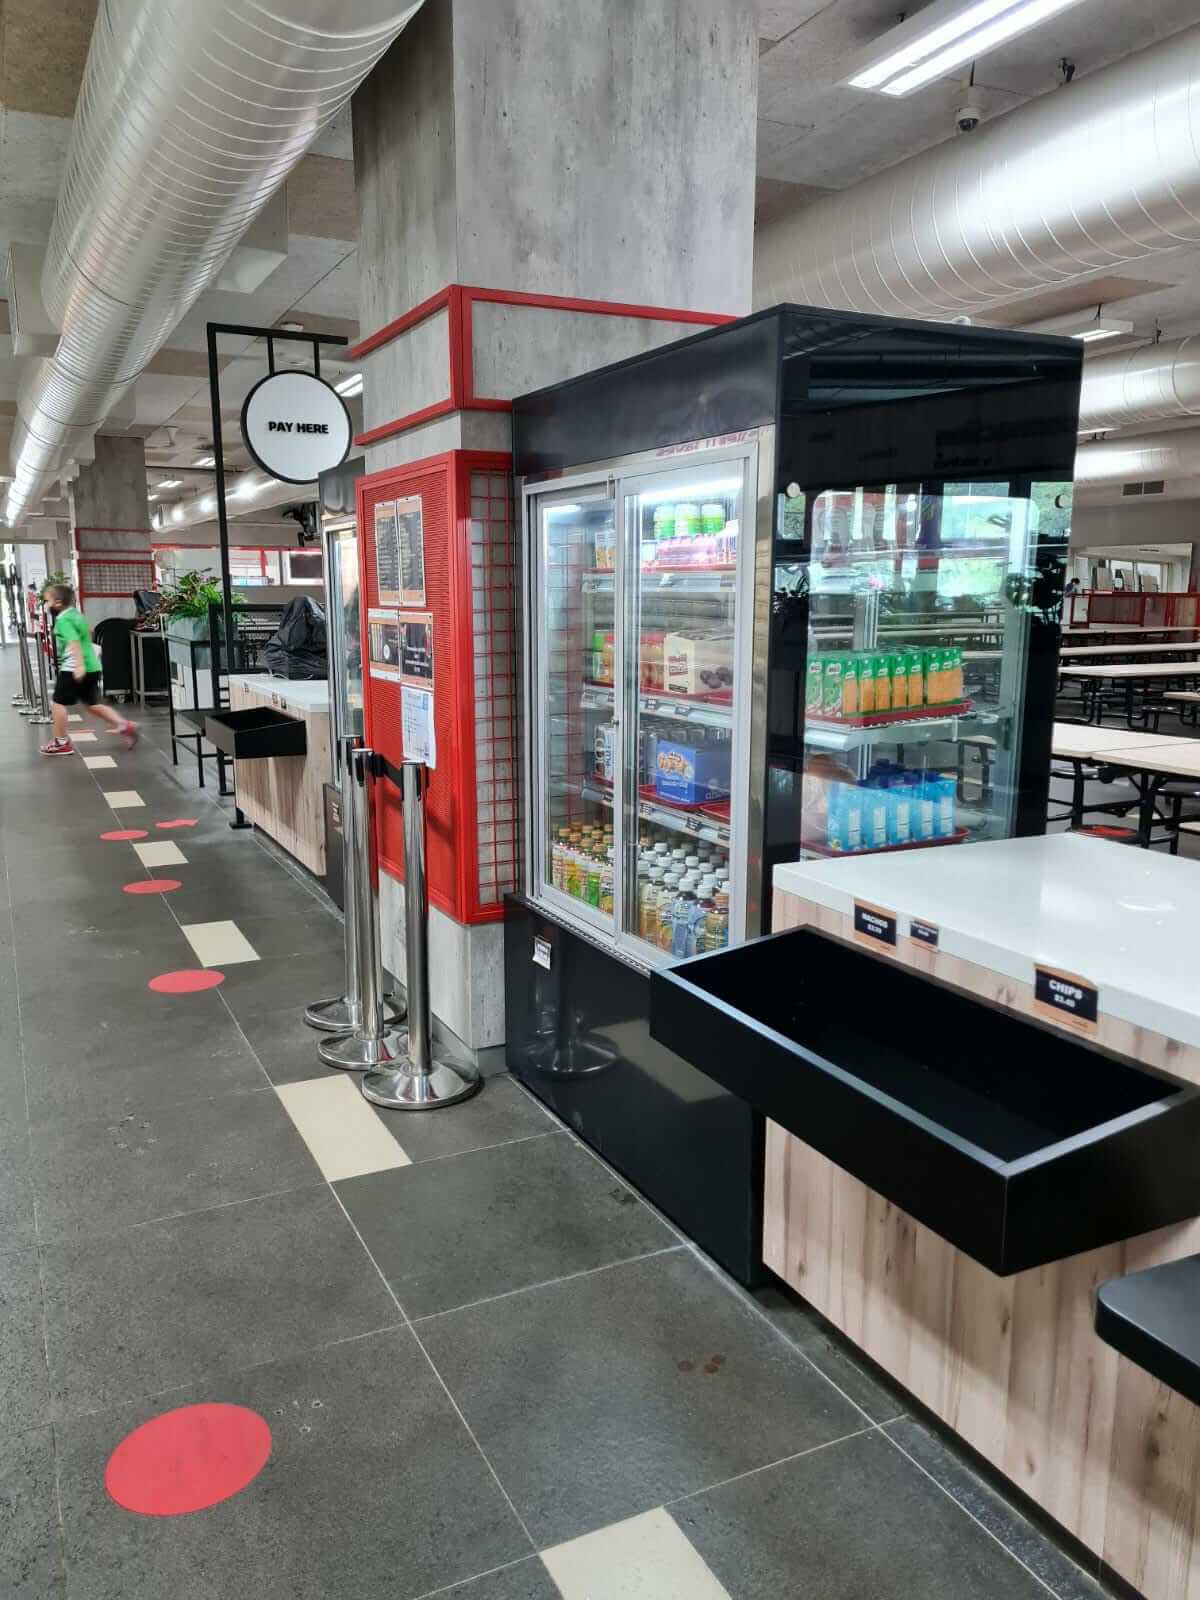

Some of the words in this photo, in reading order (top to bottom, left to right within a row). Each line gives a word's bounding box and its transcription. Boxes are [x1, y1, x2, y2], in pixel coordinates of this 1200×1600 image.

[268, 421, 293, 433] PAY
[296, 423, 329, 435] HERE
[1048, 979, 1083, 1000] CHIPS
